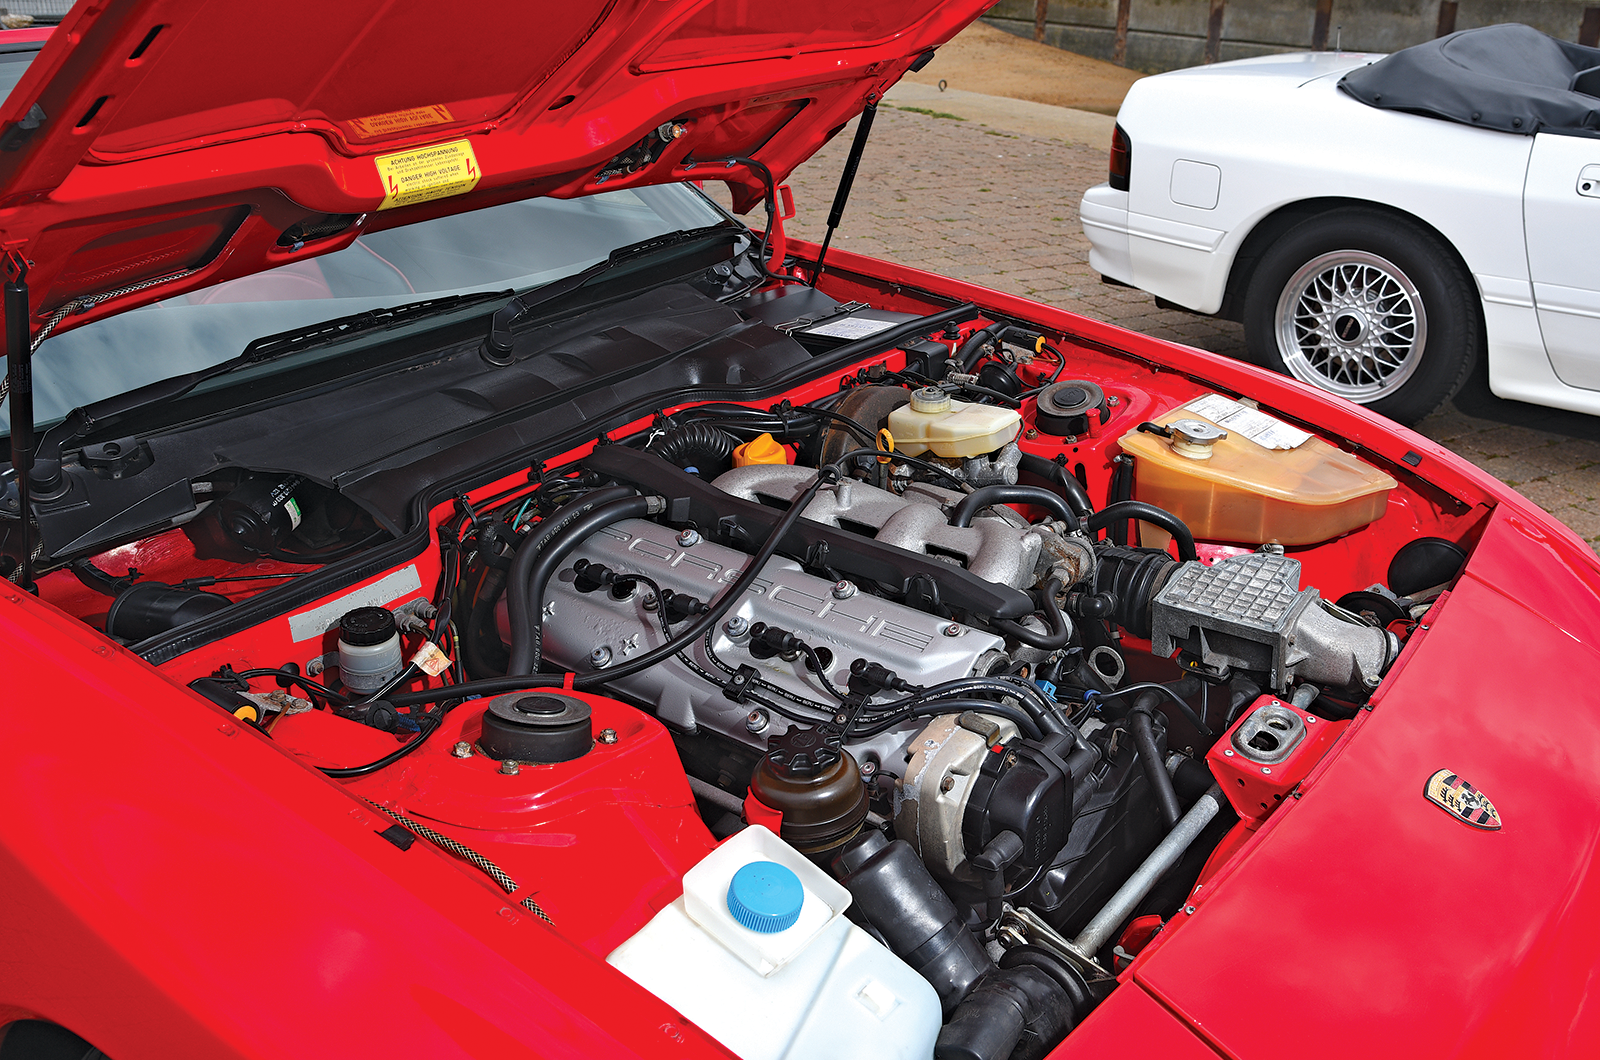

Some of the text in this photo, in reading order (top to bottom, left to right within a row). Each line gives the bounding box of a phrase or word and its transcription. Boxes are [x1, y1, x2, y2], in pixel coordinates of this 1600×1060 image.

[390, 146, 458, 166] ACHTUNG HOCHSPANNUNG
[400, 165, 461, 184] DANGER HIGH VOLTAGE
[784, 692, 797, 701] BERU
[820, 704, 834, 713] BERU
[882, 710, 896, 718] BERU
